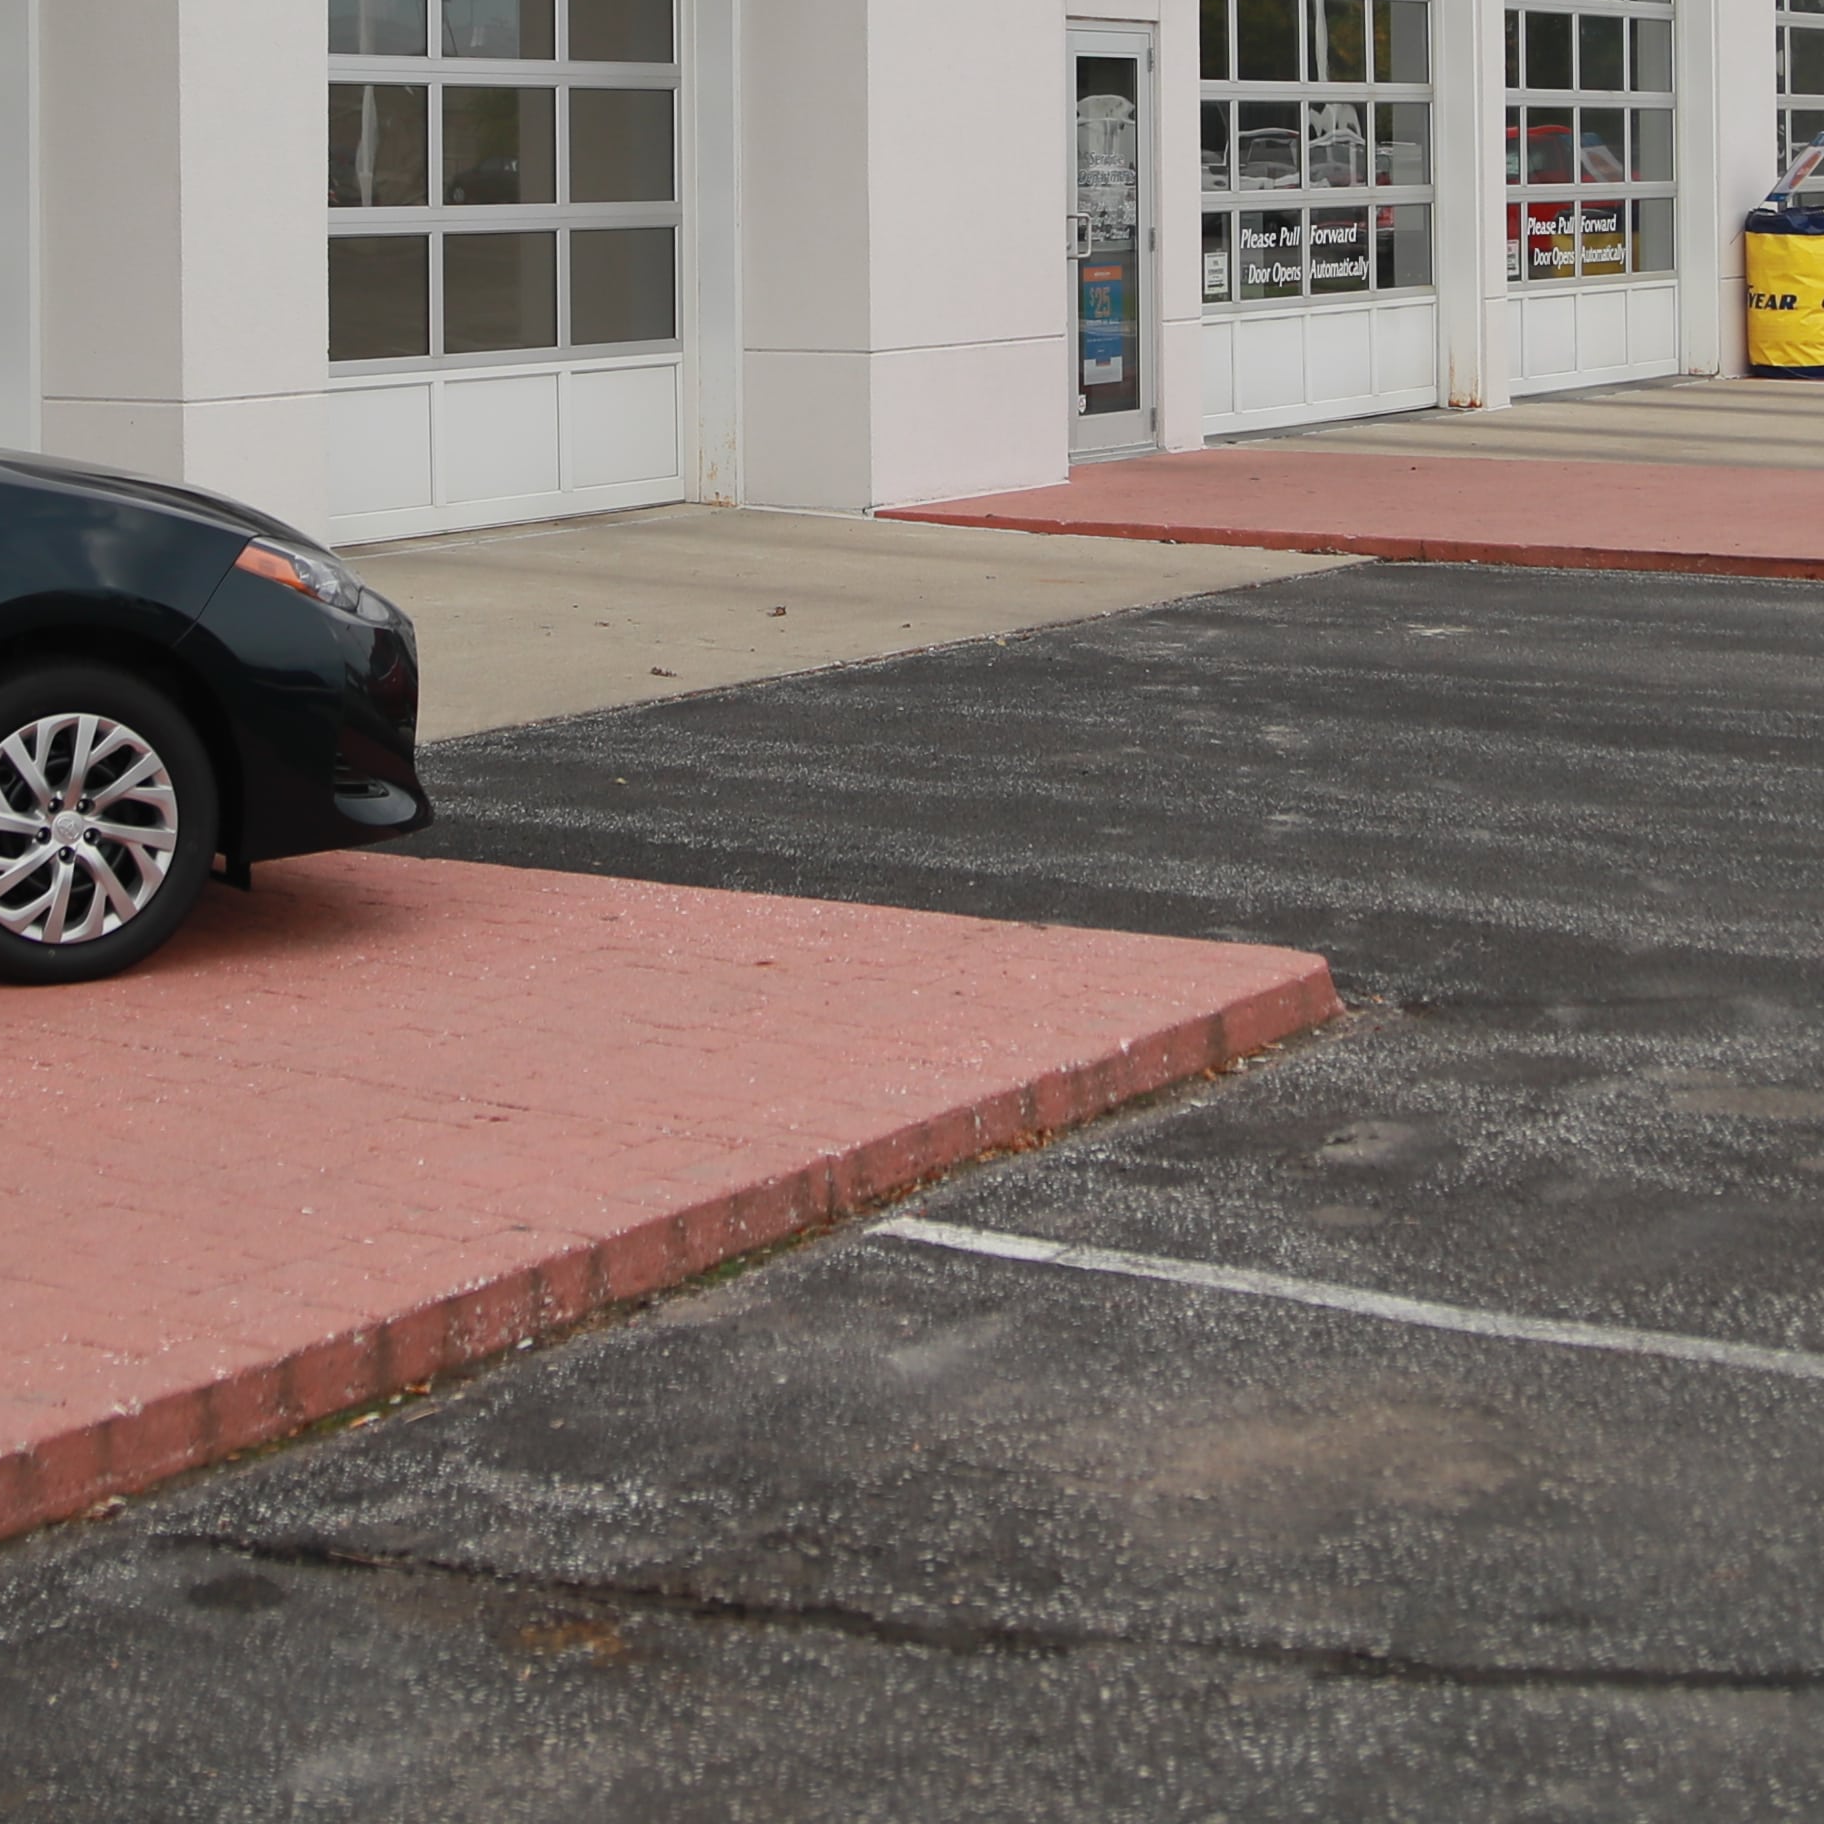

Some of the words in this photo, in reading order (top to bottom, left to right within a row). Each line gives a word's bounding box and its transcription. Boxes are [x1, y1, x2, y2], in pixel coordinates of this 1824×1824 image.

[1240, 228, 1277, 249] Please
[1279, 225, 1301, 247] Pull
[1310, 222, 1358, 245] Forward
[1527, 217, 1556, 235] Please
[1558, 216, 1575, 235] Pull
[1580, 213, 1617, 233] Forward
[1533, 248, 1553, 266] Door
[1552, 246, 1575, 270] Opens
[1581, 242, 1626, 265] Automatically
[1248, 263, 1271, 284] Door
[1272, 262, 1301, 288] Opens
[1311, 255, 1370, 281] Automatically
